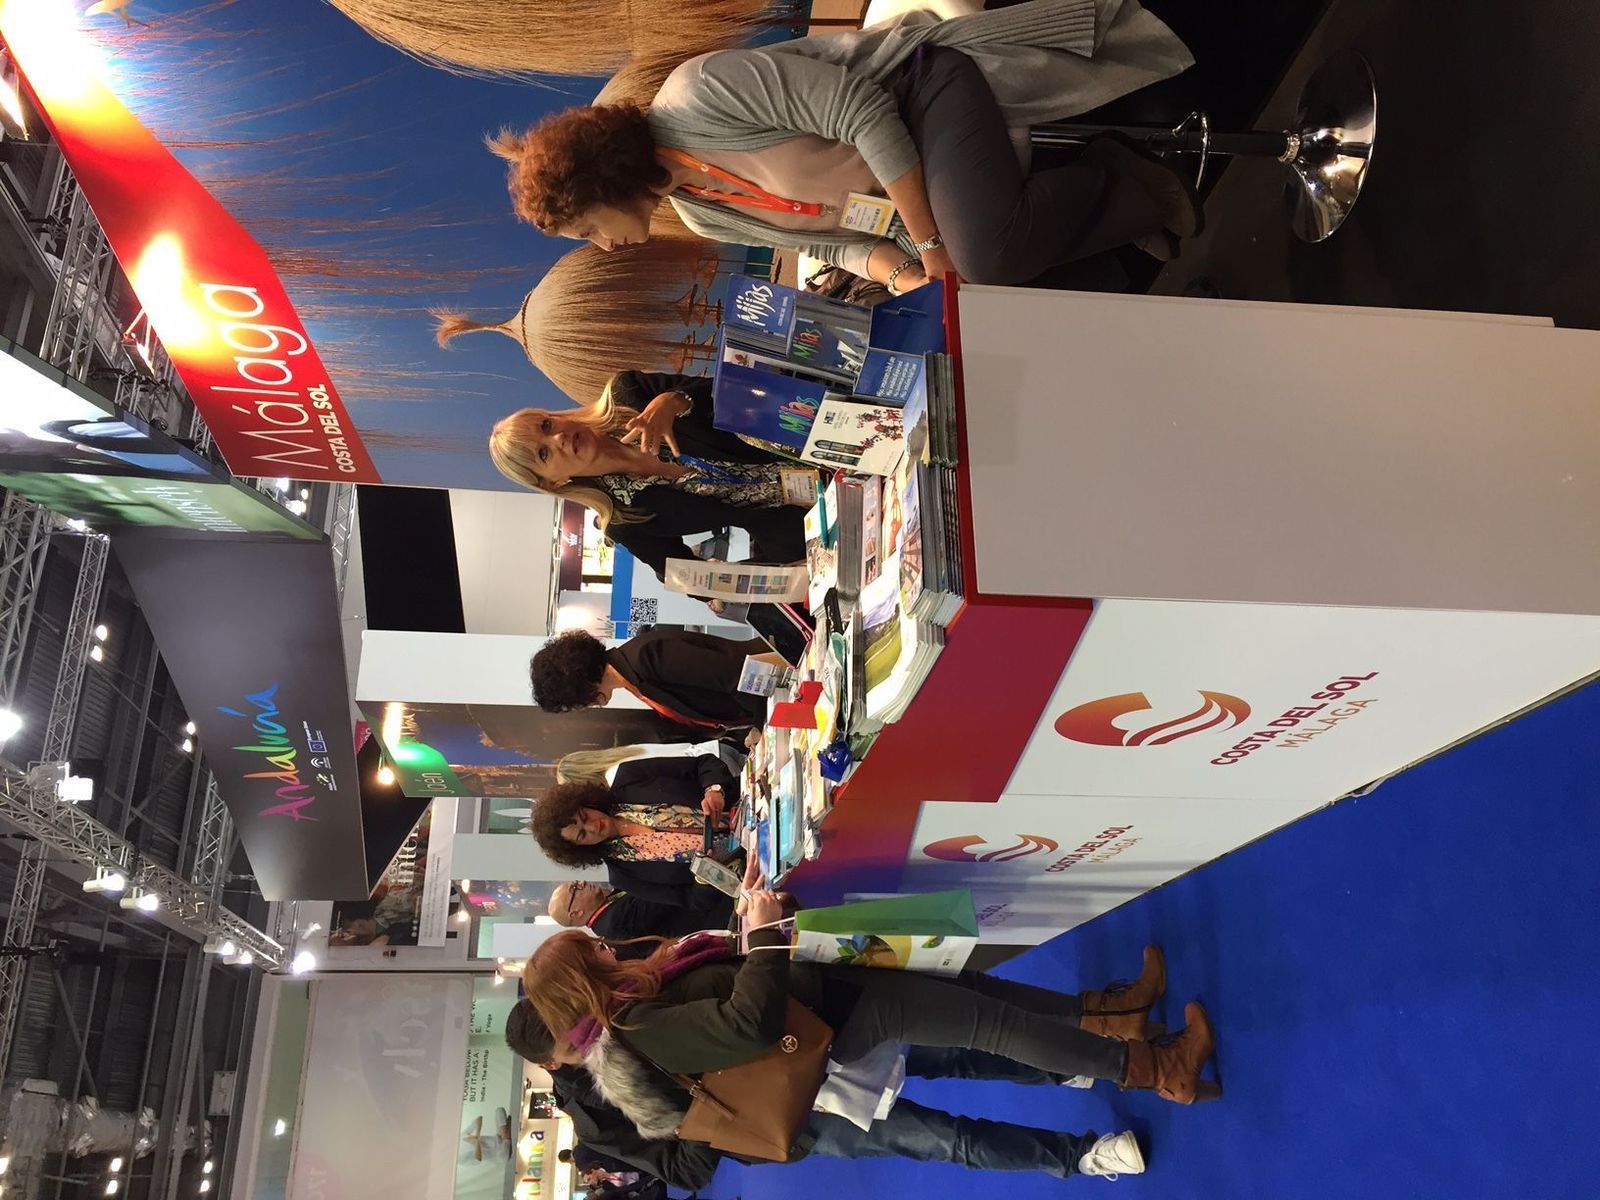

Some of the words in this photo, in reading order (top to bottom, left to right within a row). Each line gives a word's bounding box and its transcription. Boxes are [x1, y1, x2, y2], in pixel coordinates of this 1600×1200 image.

[735, 283, 777, 327] Mijas
[199, 282, 328, 470] Málaga
[306, 384, 332, 410] SOL
[319, 411, 341, 435] DEL
[328, 437, 357, 473] COSTA
[1210, 730, 1286, 766] COSTA
[1266, 703, 1329, 727] DEL
[1310, 672, 1379, 700] SOL
[1276, 699, 1379, 748] MÁLAGA
[215, 681, 318, 822] Andalucía
[414, 772, 455, 794] Jaén
[1044, 853, 1089, 873] COSTA
[1074, 840, 1110, 853] DEL
[1095, 825, 1134, 839] SOL
[1087, 837, 1144, 864] MÁLAGA
[469, 1086, 477, 1102] BUT
